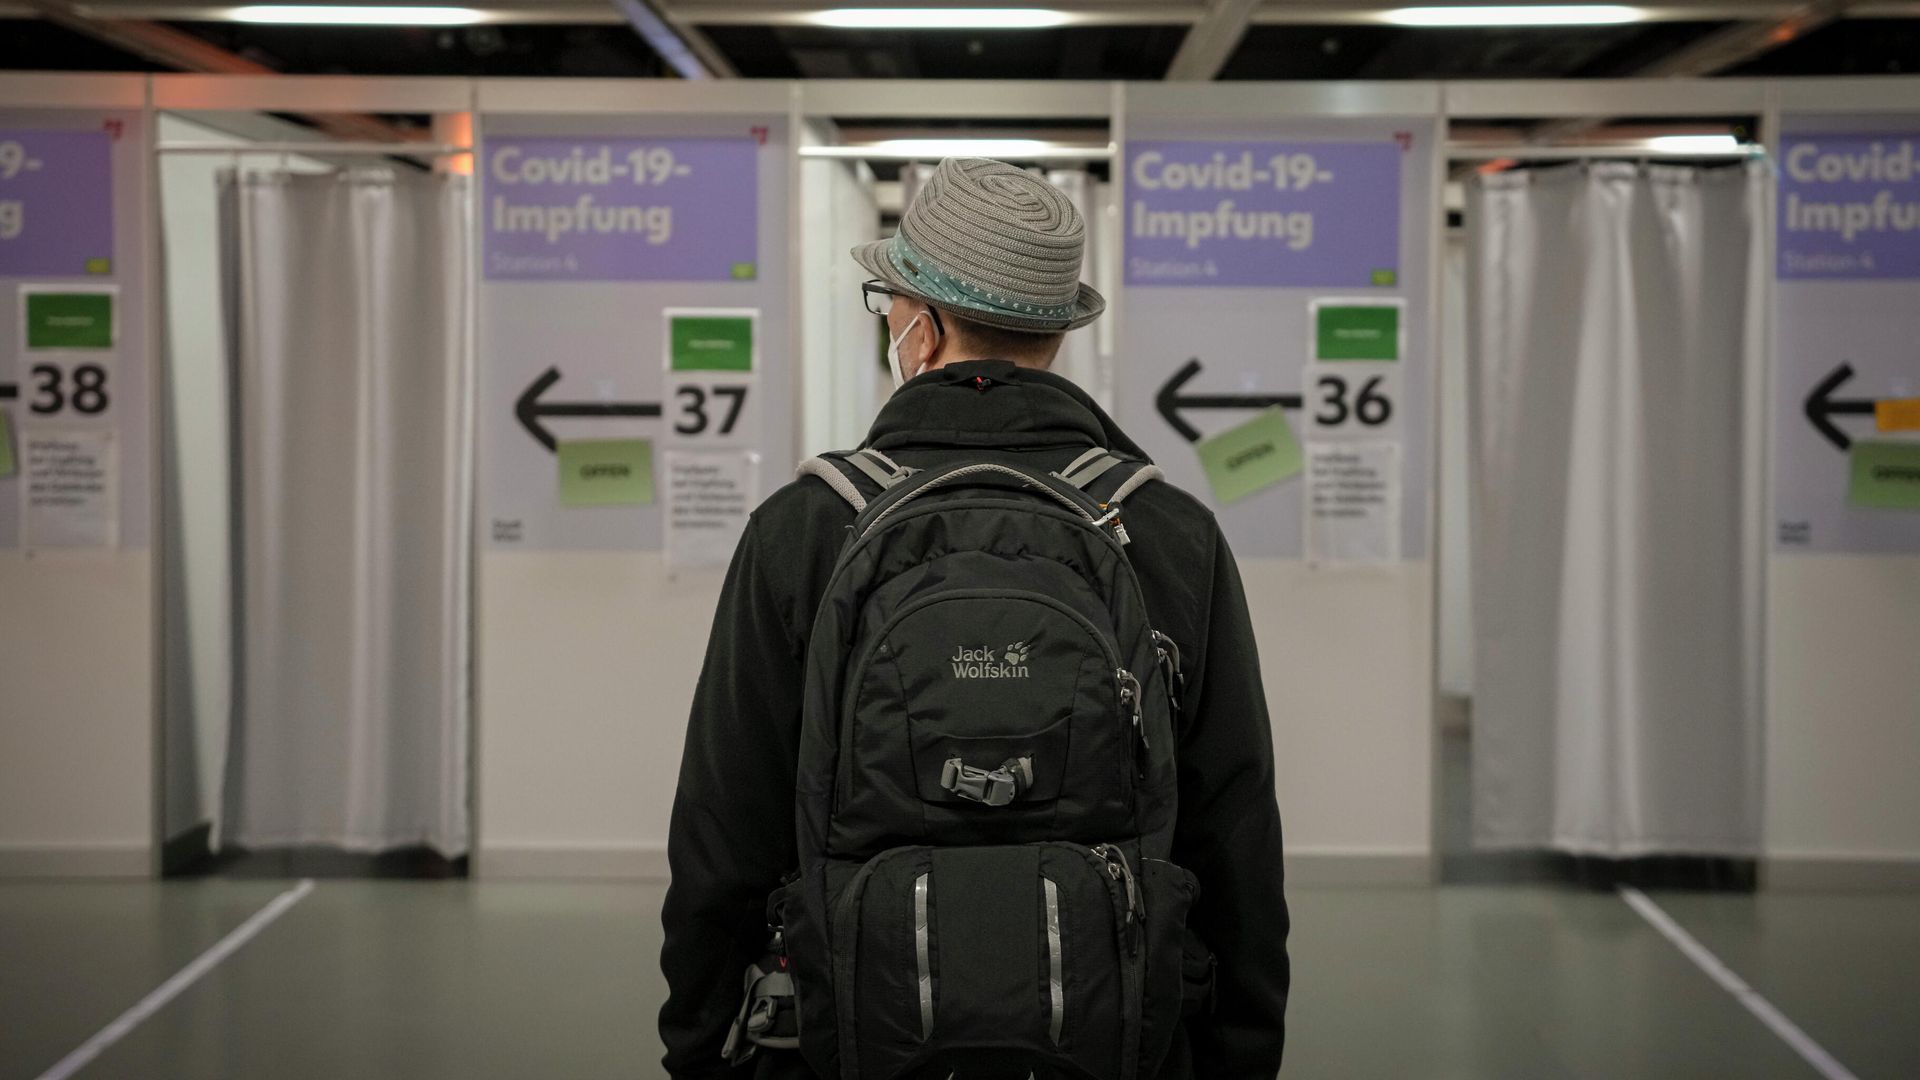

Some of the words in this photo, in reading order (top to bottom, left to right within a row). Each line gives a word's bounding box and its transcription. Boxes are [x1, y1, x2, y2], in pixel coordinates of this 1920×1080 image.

[493, 146, 692, 186] Covid-19-
[1132, 151, 1335, 190] Covid-19-
[493, 194, 673, 244] Impfung
[1133, 200, 1312, 252] Impfung
[29, 364, 108, 415] 38
[674, 385, 747, 434] 37
[1315, 376, 1393, 427] 36
[951, 662, 1030, 679] Wolfskin
[952, 645, 995, 662] Jack
